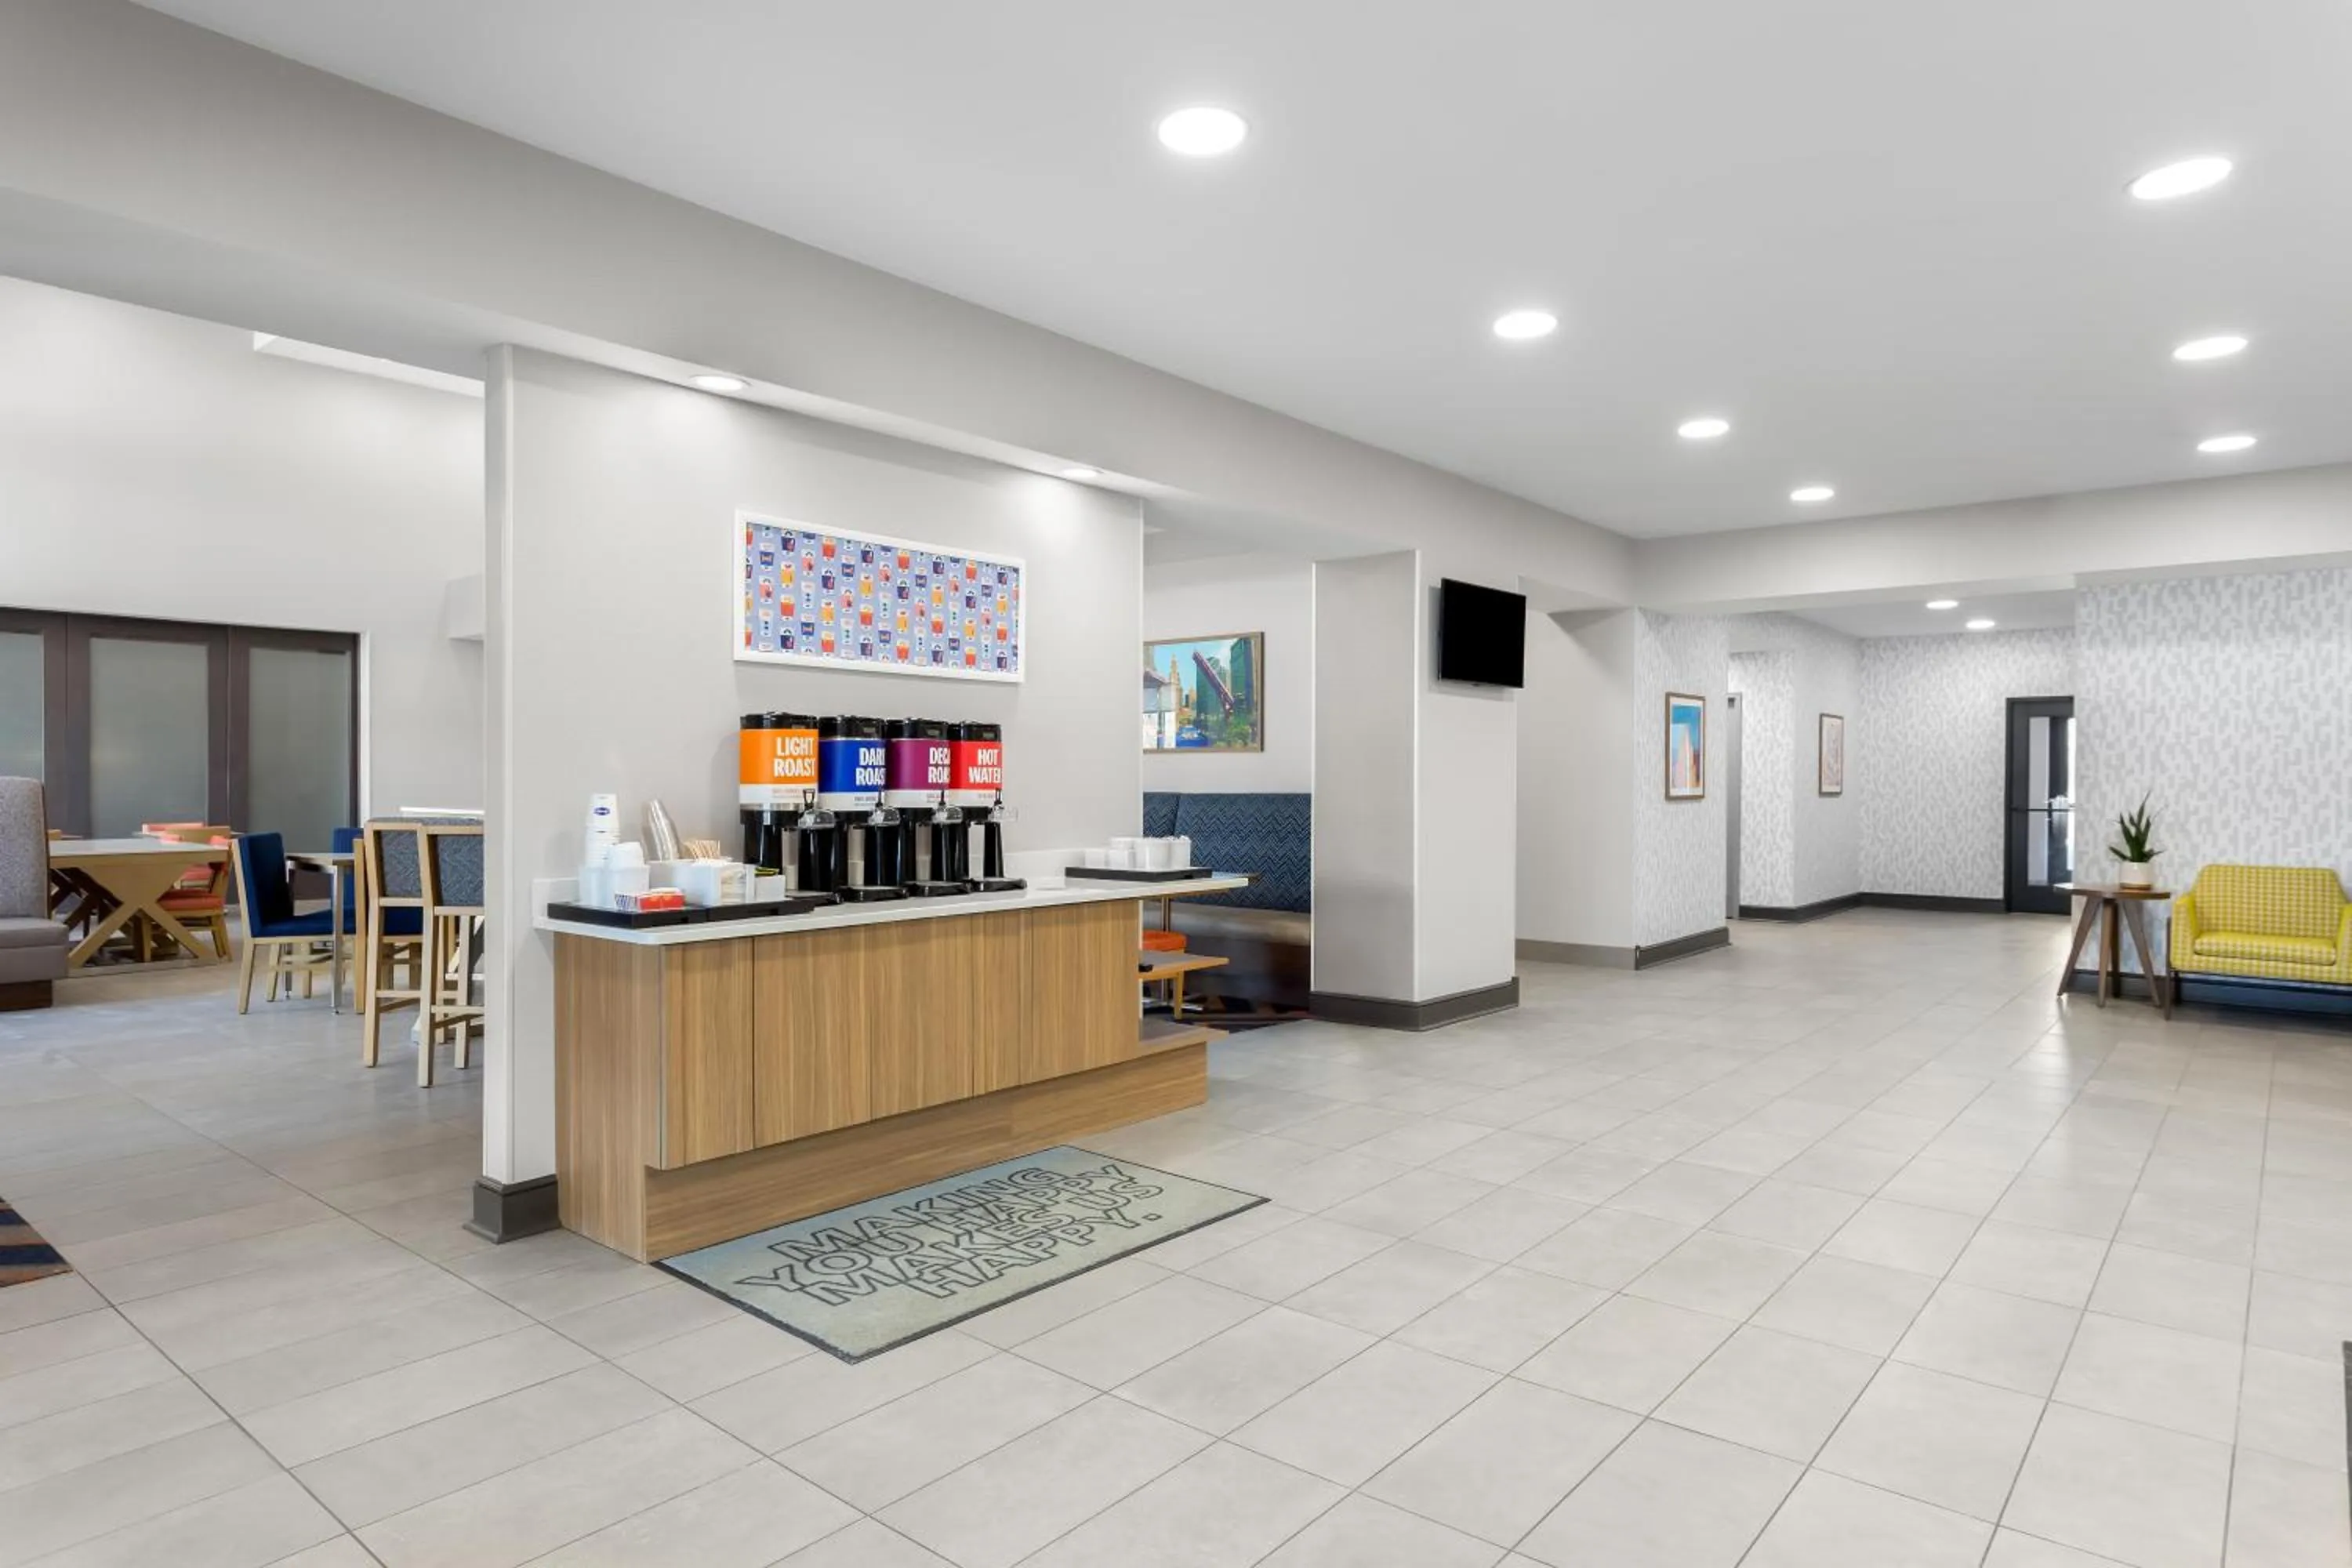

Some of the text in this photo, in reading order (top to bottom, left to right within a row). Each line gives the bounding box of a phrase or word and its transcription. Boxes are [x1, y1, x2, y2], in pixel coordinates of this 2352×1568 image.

[774, 757, 816, 778] ROAST
[776, 736, 815, 757] LIGHT
[978, 749, 1000, 766] HOT
[856, 768, 886, 786] ROAS
[734, 1163, 1138, 1292] YOU HAPPY
[768, 1167, 1066, 1263] MAKING
[801, 1181, 1164, 1306] MAKES US
[905, 1207, 1163, 1299] HAPPY.
